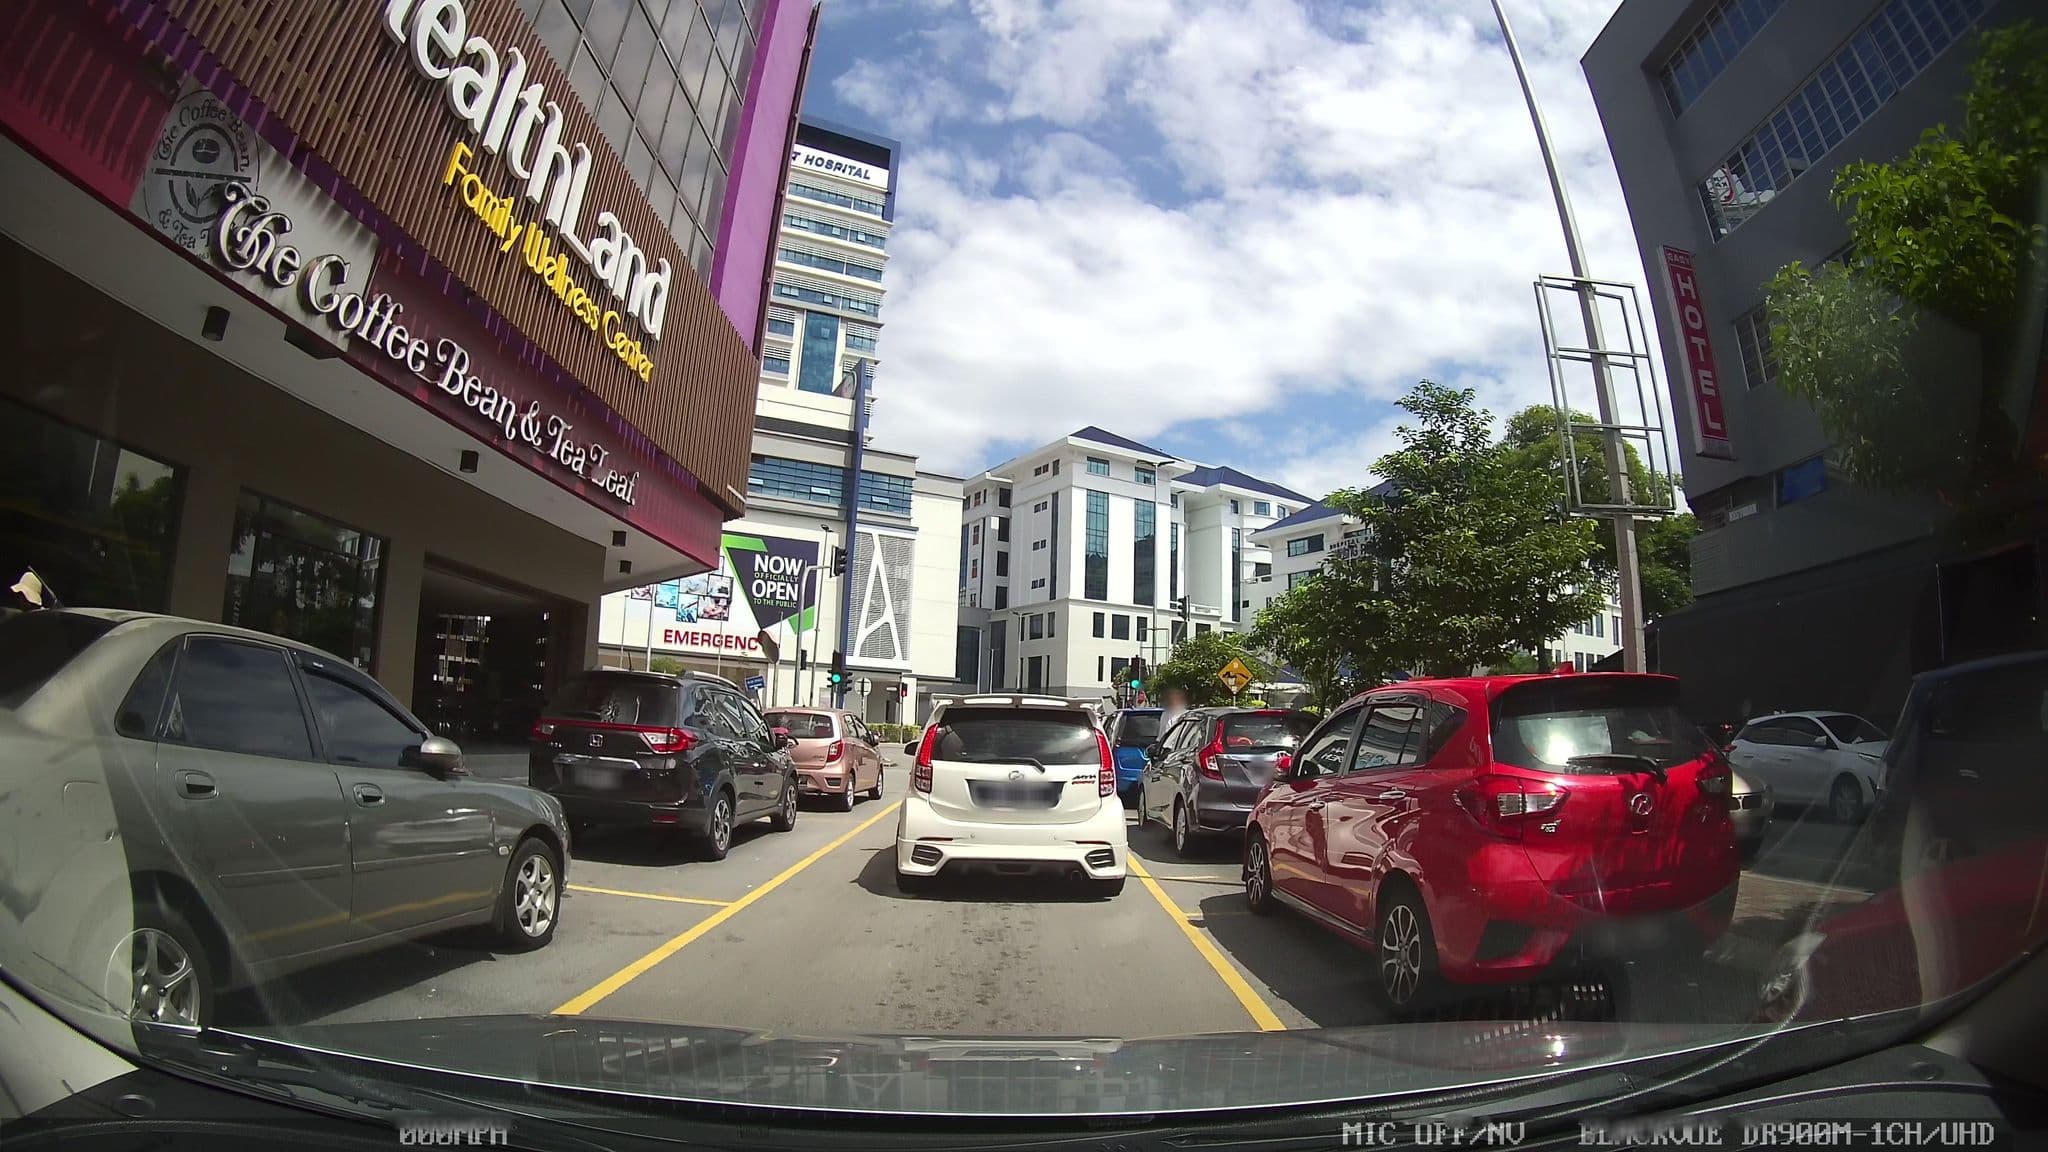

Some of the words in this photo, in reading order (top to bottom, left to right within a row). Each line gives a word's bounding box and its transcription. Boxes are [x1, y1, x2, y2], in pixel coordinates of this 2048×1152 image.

[179, 100, 227, 128] Coffee
[384, 0, 672, 341] ealthLand
[803, 154, 871, 180] HOSPITAL
[444, 141, 523, 252] Family
[523, 222, 600, 331] Wellness
[602, 311, 654, 382] Center
[218, 181, 300, 287] The
[307, 254, 434, 375] Coffee
[436, 337, 517, 440] Bean
[519, 401, 542, 447] &
[548, 414, 586, 476] Tea
[1676, 272, 1722, 431] HOTEL
[754, 554, 803, 577] NOW
[754, 572, 799, 583] OFFICIALLY
[752, 580, 798, 601] OPEN
[754, 597, 762, 605] TO
[763, 599, 773, 607] THE
[775, 600, 797, 609] PUBLIC
[664, 629, 760, 651] EMERGENC
